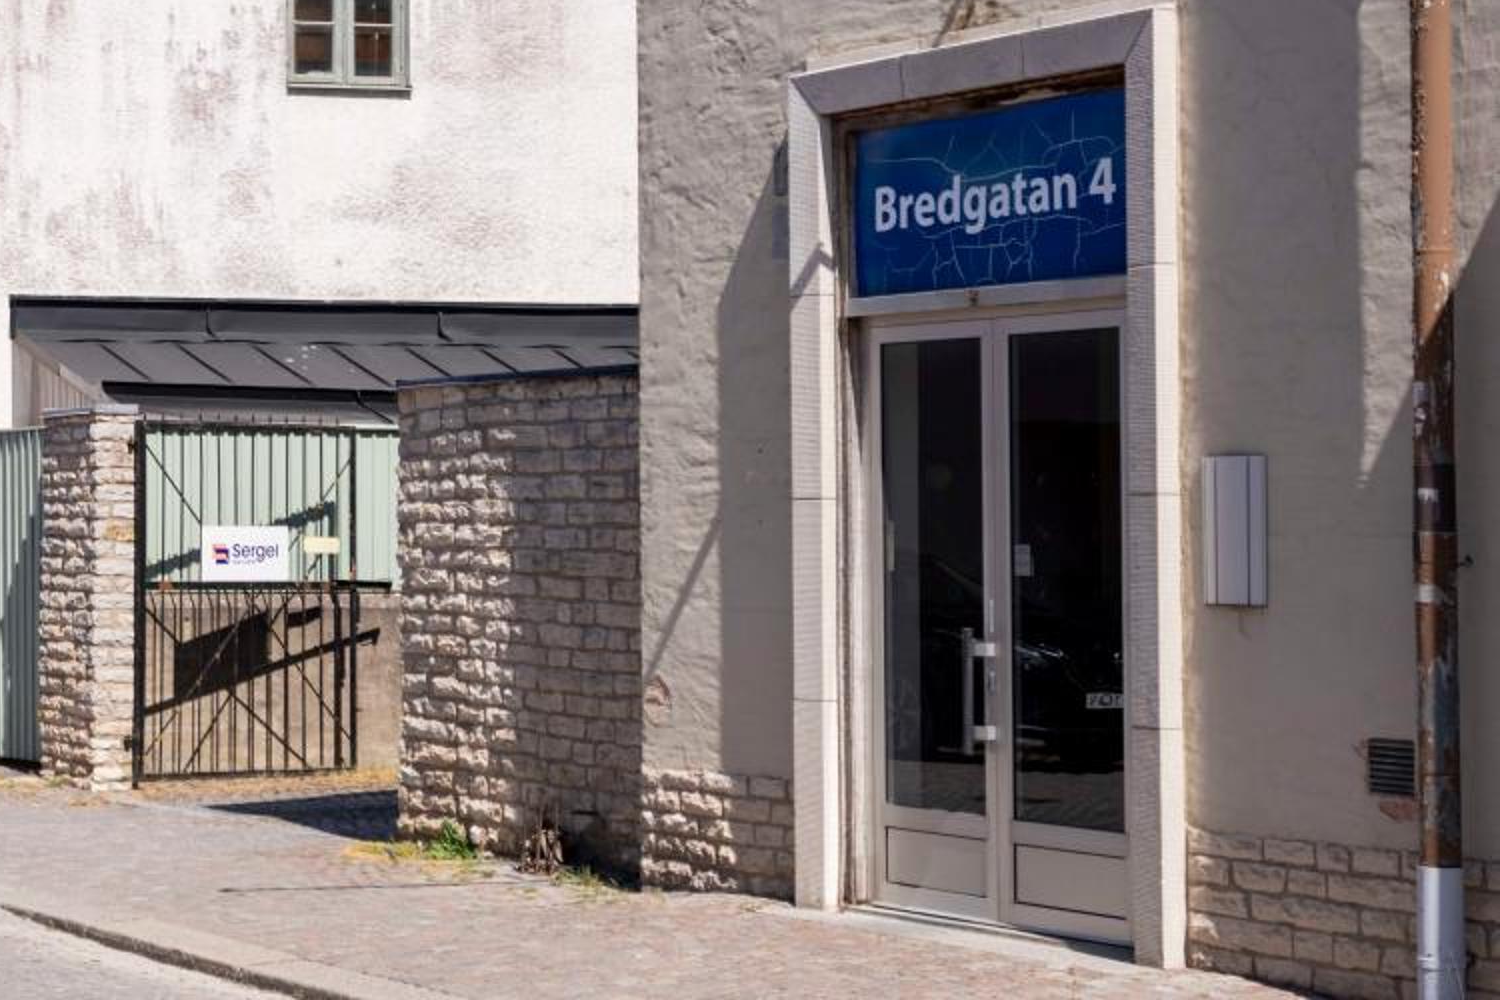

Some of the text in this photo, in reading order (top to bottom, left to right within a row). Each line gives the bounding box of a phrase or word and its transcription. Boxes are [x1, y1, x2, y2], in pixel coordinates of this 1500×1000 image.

[875, 157, 1117, 235] Bredgatan 4
[232, 543, 279, 563] Sergel
